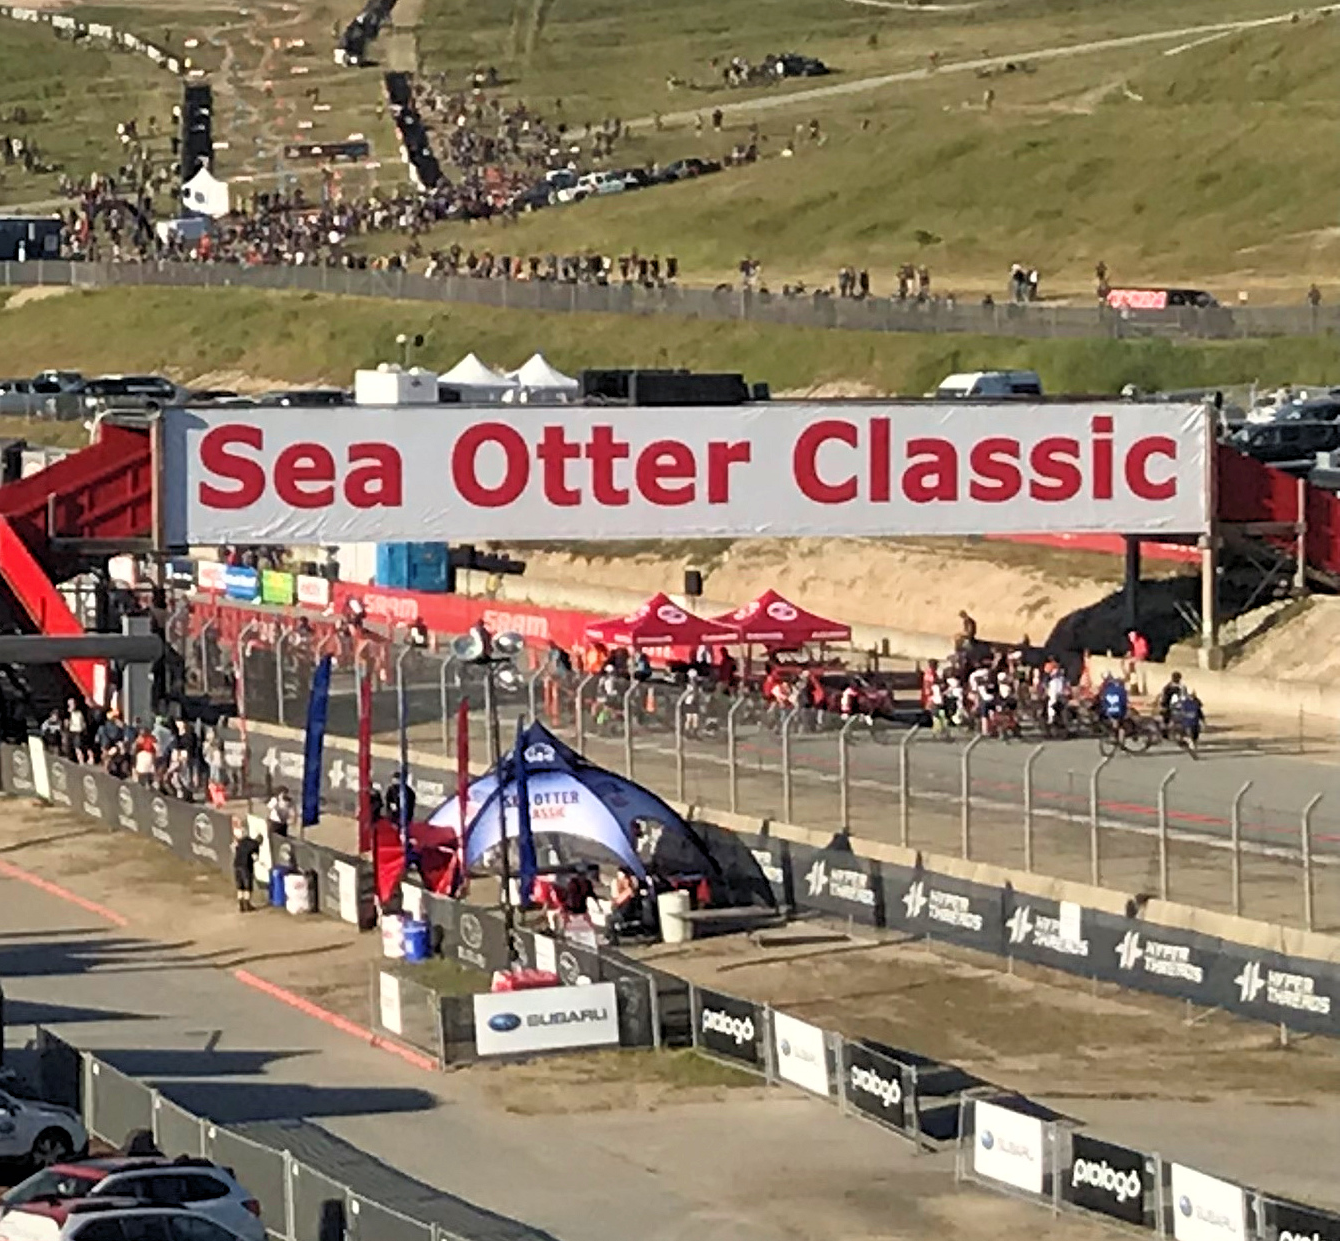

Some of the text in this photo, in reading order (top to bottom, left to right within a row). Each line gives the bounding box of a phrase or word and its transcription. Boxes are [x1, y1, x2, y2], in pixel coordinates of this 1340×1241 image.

[199, 416, 1178, 509] Sea Otter Classic
[364, 594, 418, 621] SRAM
[484, 610, 549, 638] SRAM
[534, 791, 579, 806] OTTER
[527, 1008, 607, 1027] SUBARU
